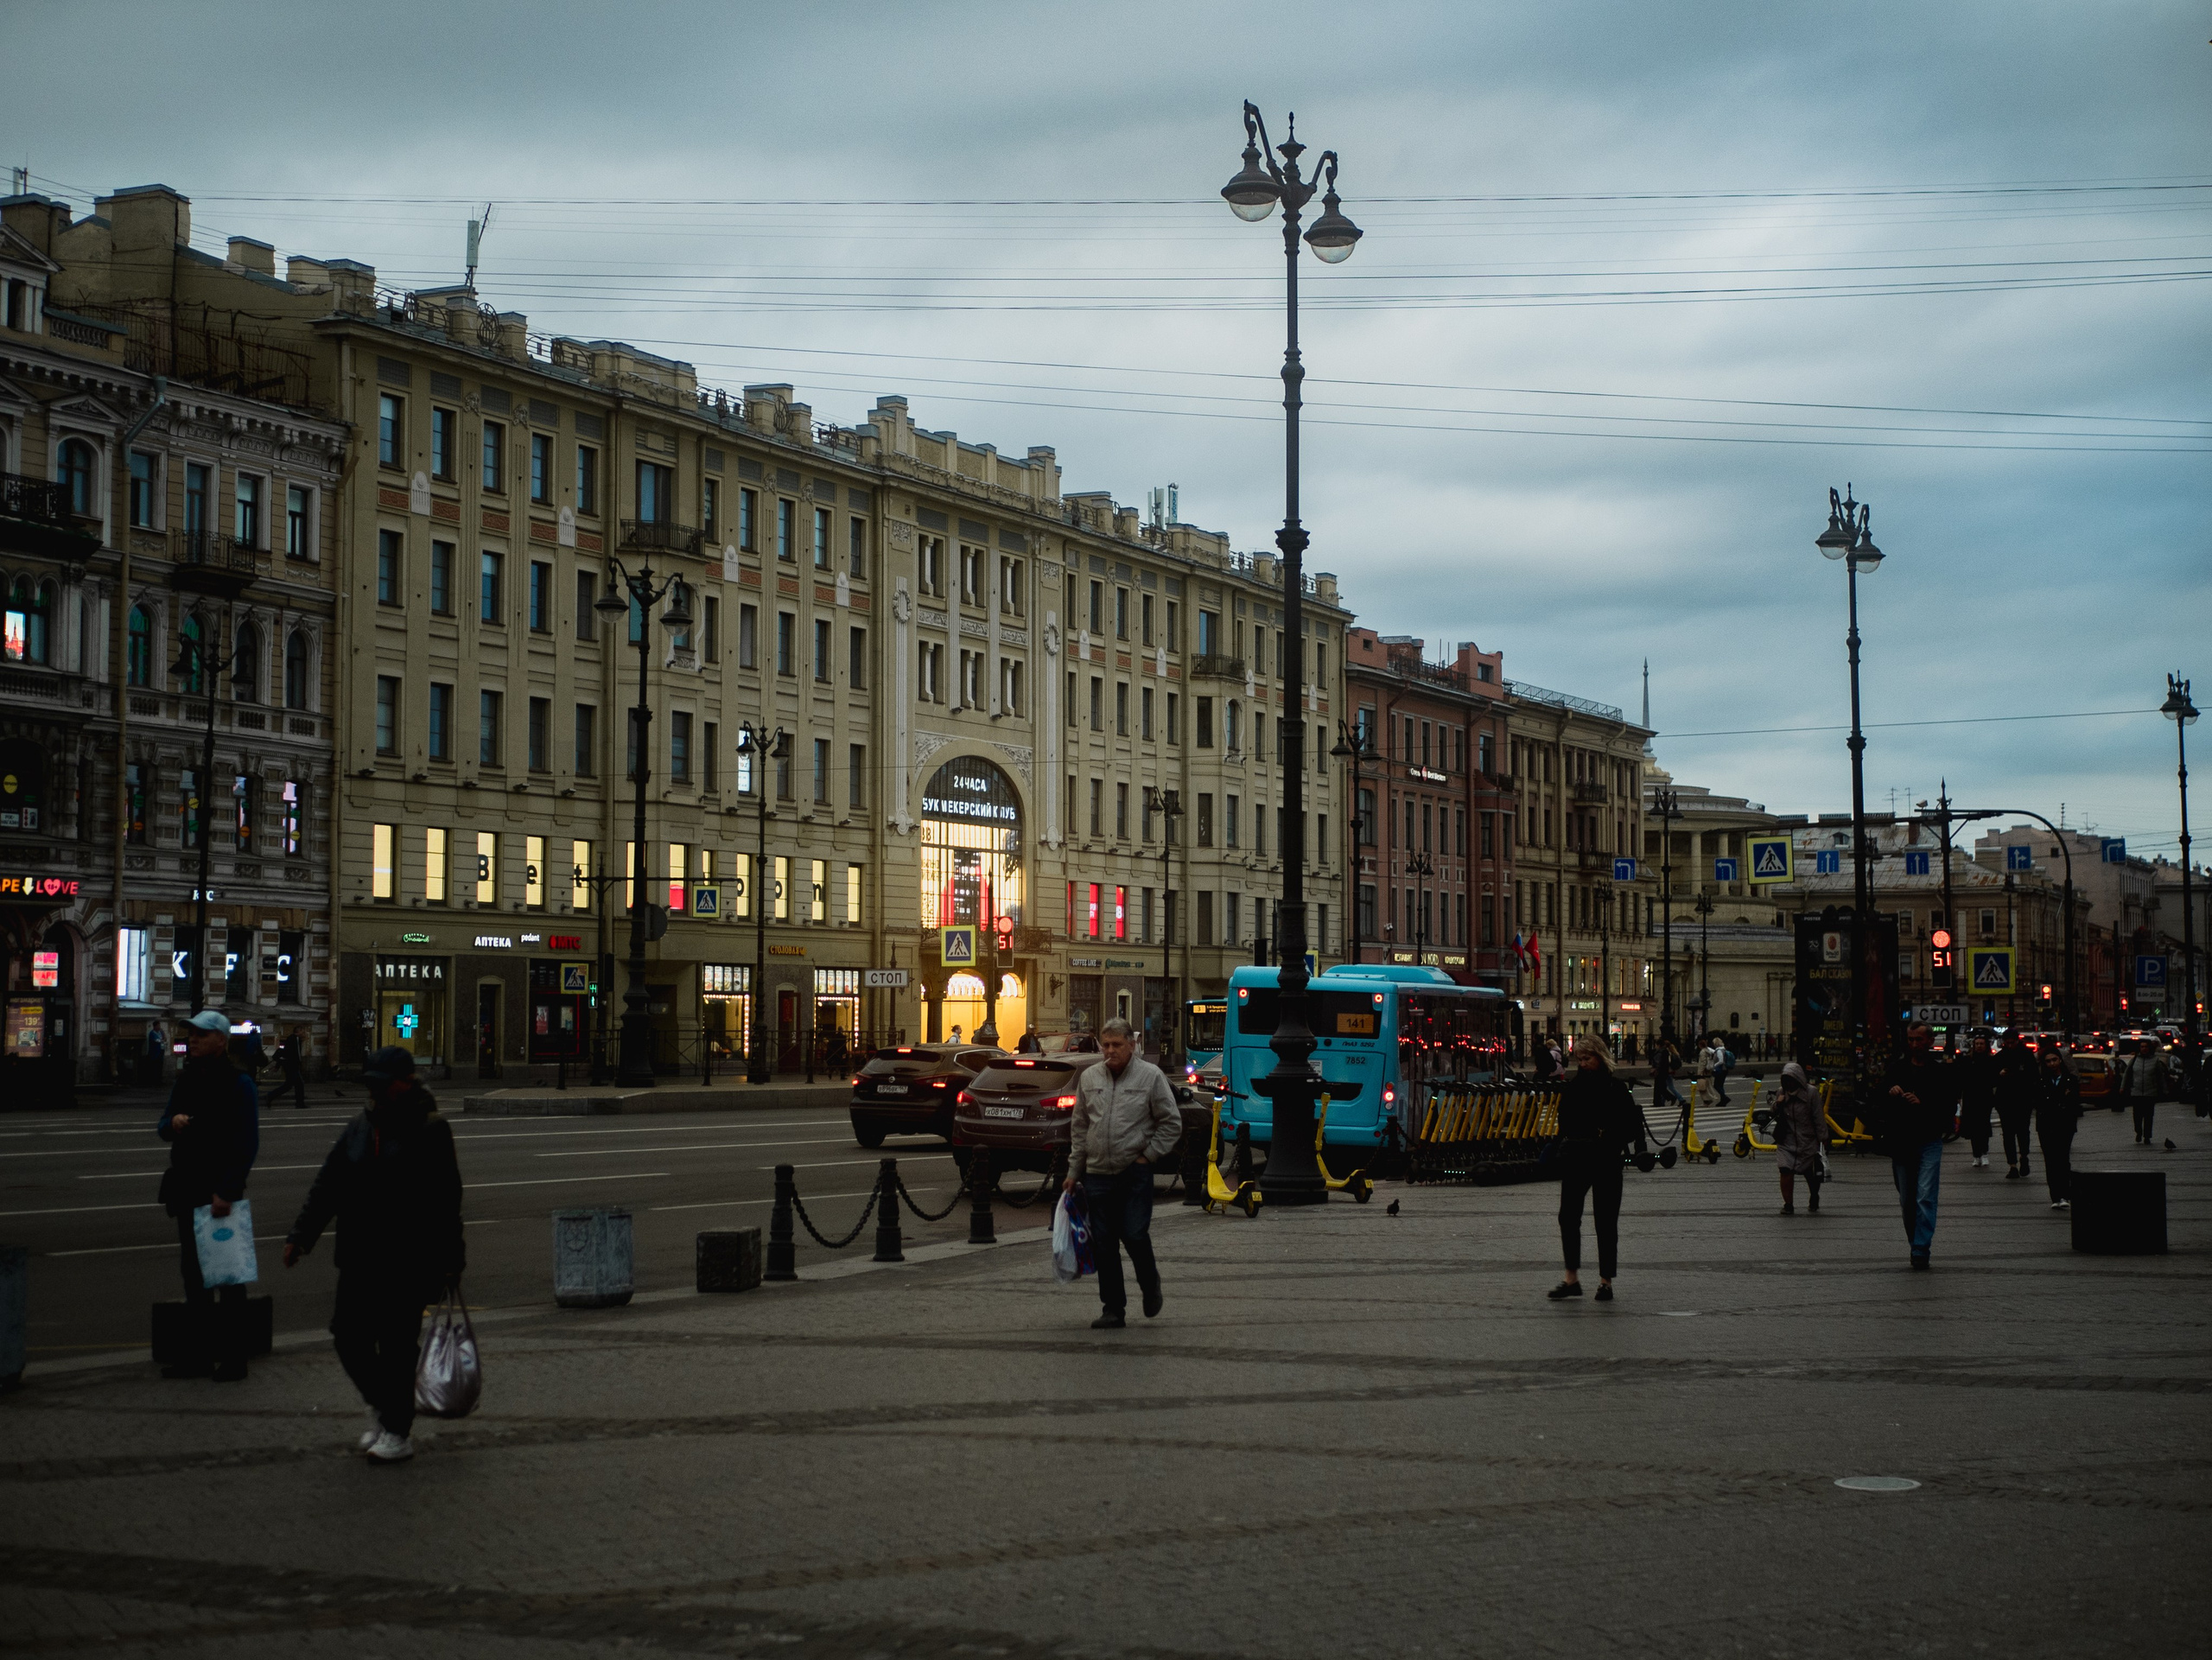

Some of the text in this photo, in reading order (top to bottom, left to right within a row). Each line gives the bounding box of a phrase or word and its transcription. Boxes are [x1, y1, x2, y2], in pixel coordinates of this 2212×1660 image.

[474, 936, 512, 948] АПТЕКА
[998, 935, 1014, 950] 51
[770, 945, 799, 955] СТОЛОВАЯ
[1933, 951, 1951, 967] 51
[375, 964, 442, 979] АПТЕКА
[1809, 969, 1827, 979] БАЛ
[870, 972, 902, 984] СТОП
[1919, 1008, 1961, 1021] СТОП
[1346, 1019, 1364, 1028] 141
[1345, 1056, 1366, 1065] 7852
